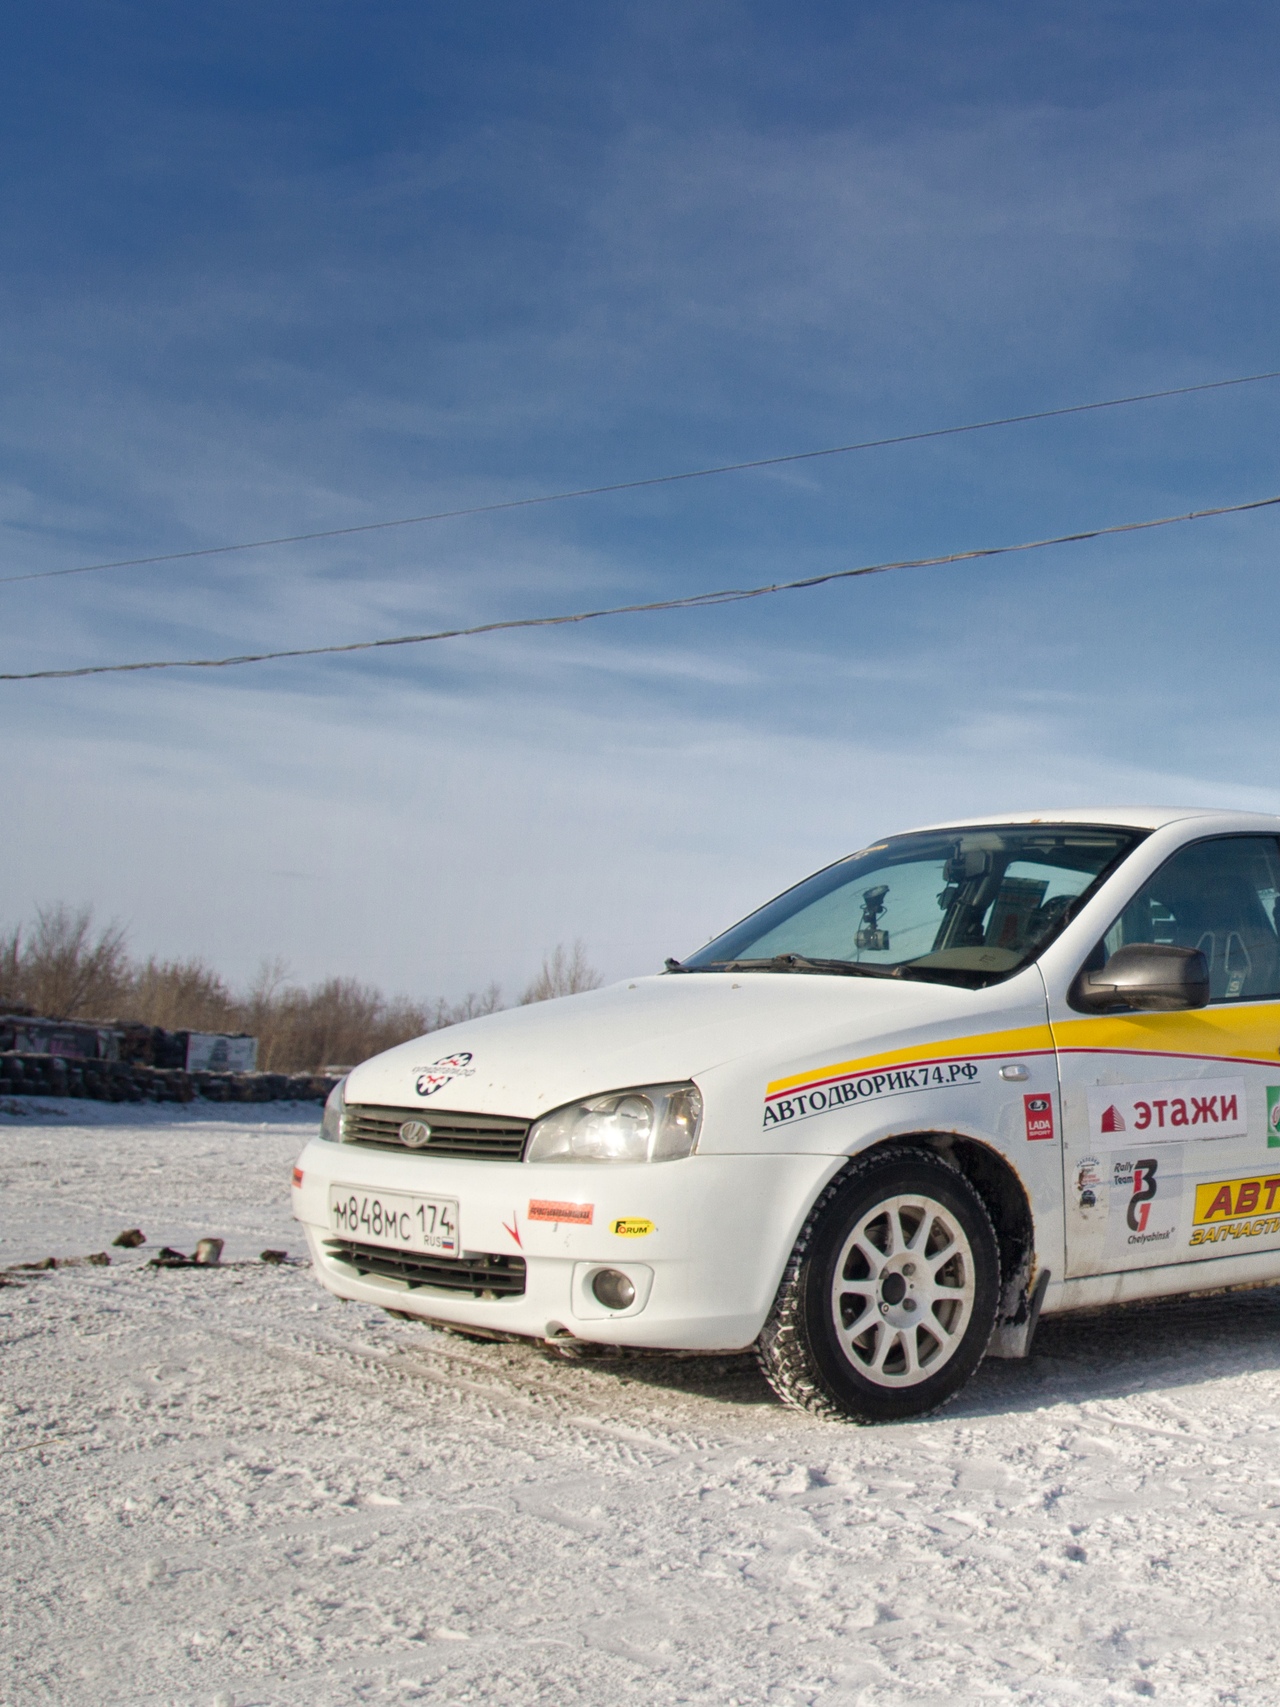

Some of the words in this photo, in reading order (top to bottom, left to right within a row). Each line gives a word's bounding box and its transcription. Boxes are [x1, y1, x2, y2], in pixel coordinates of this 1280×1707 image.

[762, 1062, 979, 1127] АВТОДВОРИК74.РФ
[1028, 1120, 1051, 1130] LADA
[1114, 1162, 1134, 1173] Rally
[1114, 1175, 1133, 1185] Team
[416, 1204, 450, 1236] 174
[615, 1220, 647, 1234] FORUM
[424, 1235, 441, 1247] RUS
[1127, 1230, 1170, 1245] Chelyabinsk
